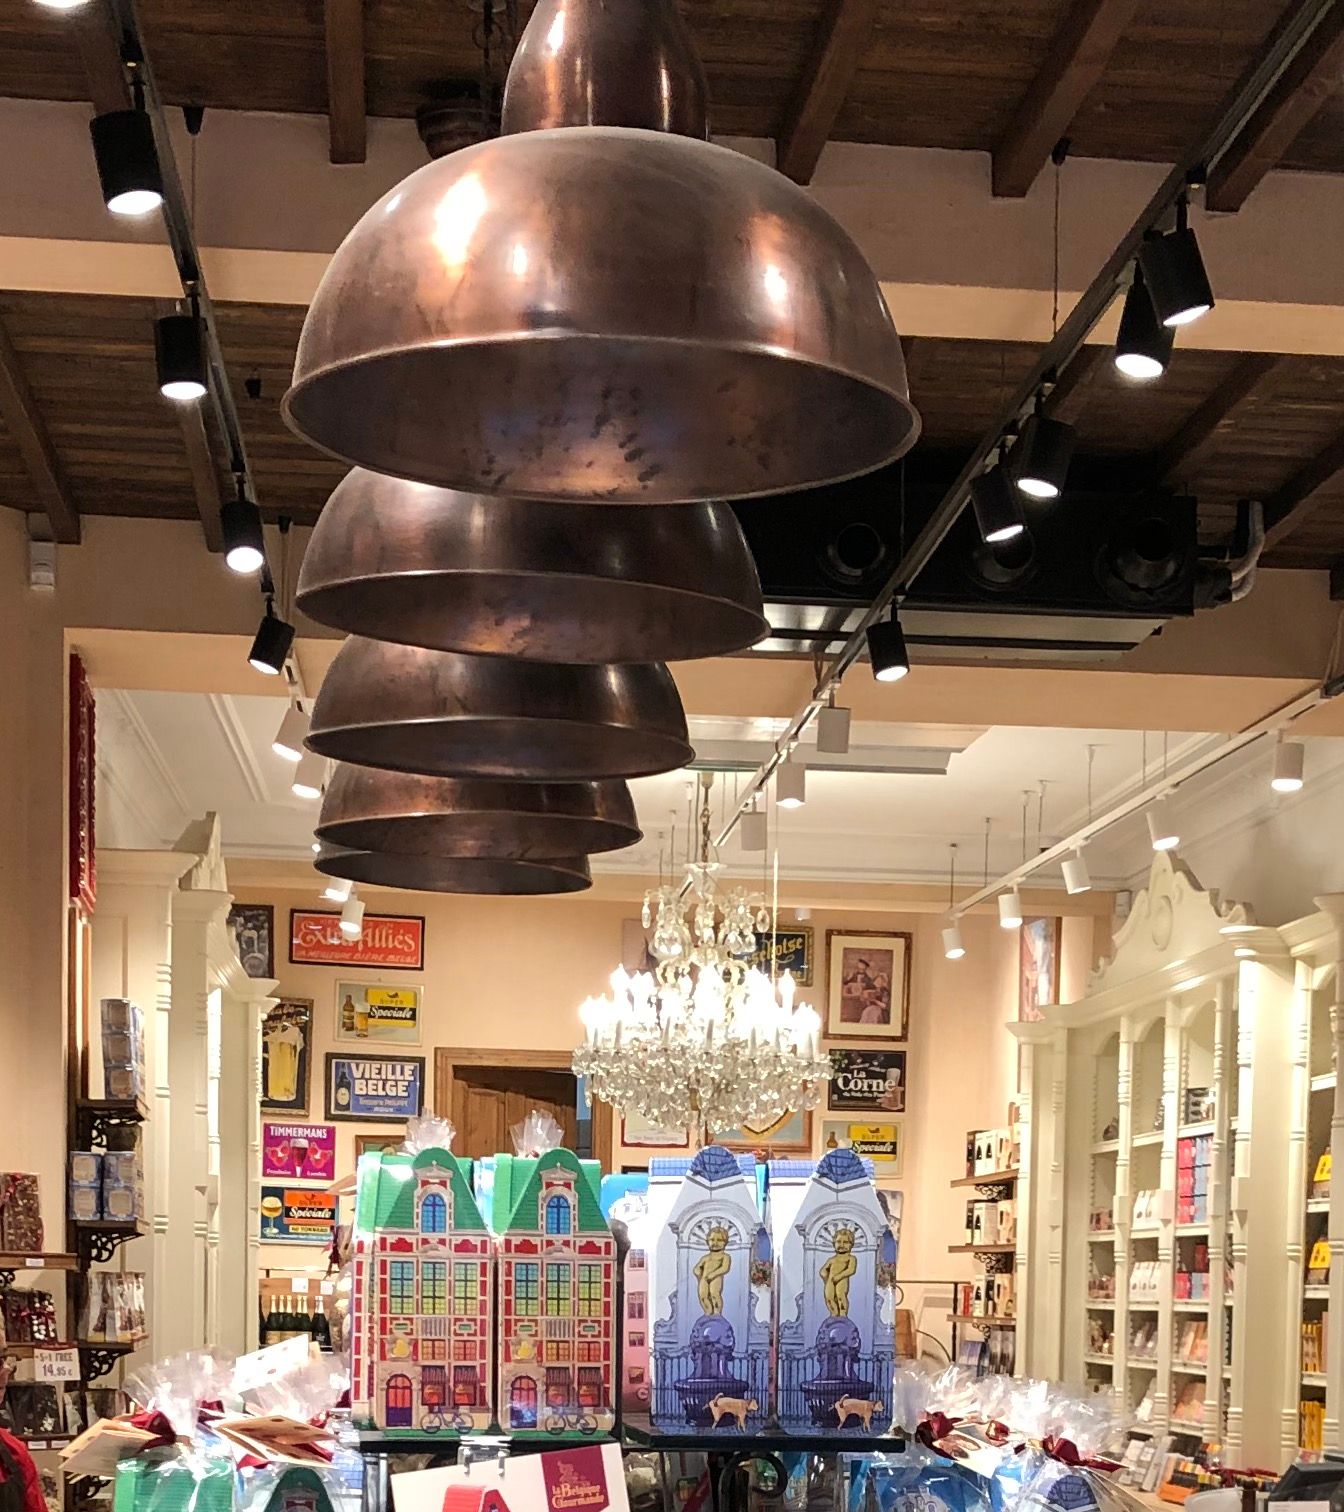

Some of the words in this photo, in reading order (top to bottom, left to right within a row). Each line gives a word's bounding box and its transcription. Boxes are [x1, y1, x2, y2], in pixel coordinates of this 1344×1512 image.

[350, 1062, 415, 1081] VIEILLE
[354, 1080, 409, 1097] BELGE
[837, 1072, 896, 1092] Corne
[269, 1125, 328, 1139] TIMMERMANS
